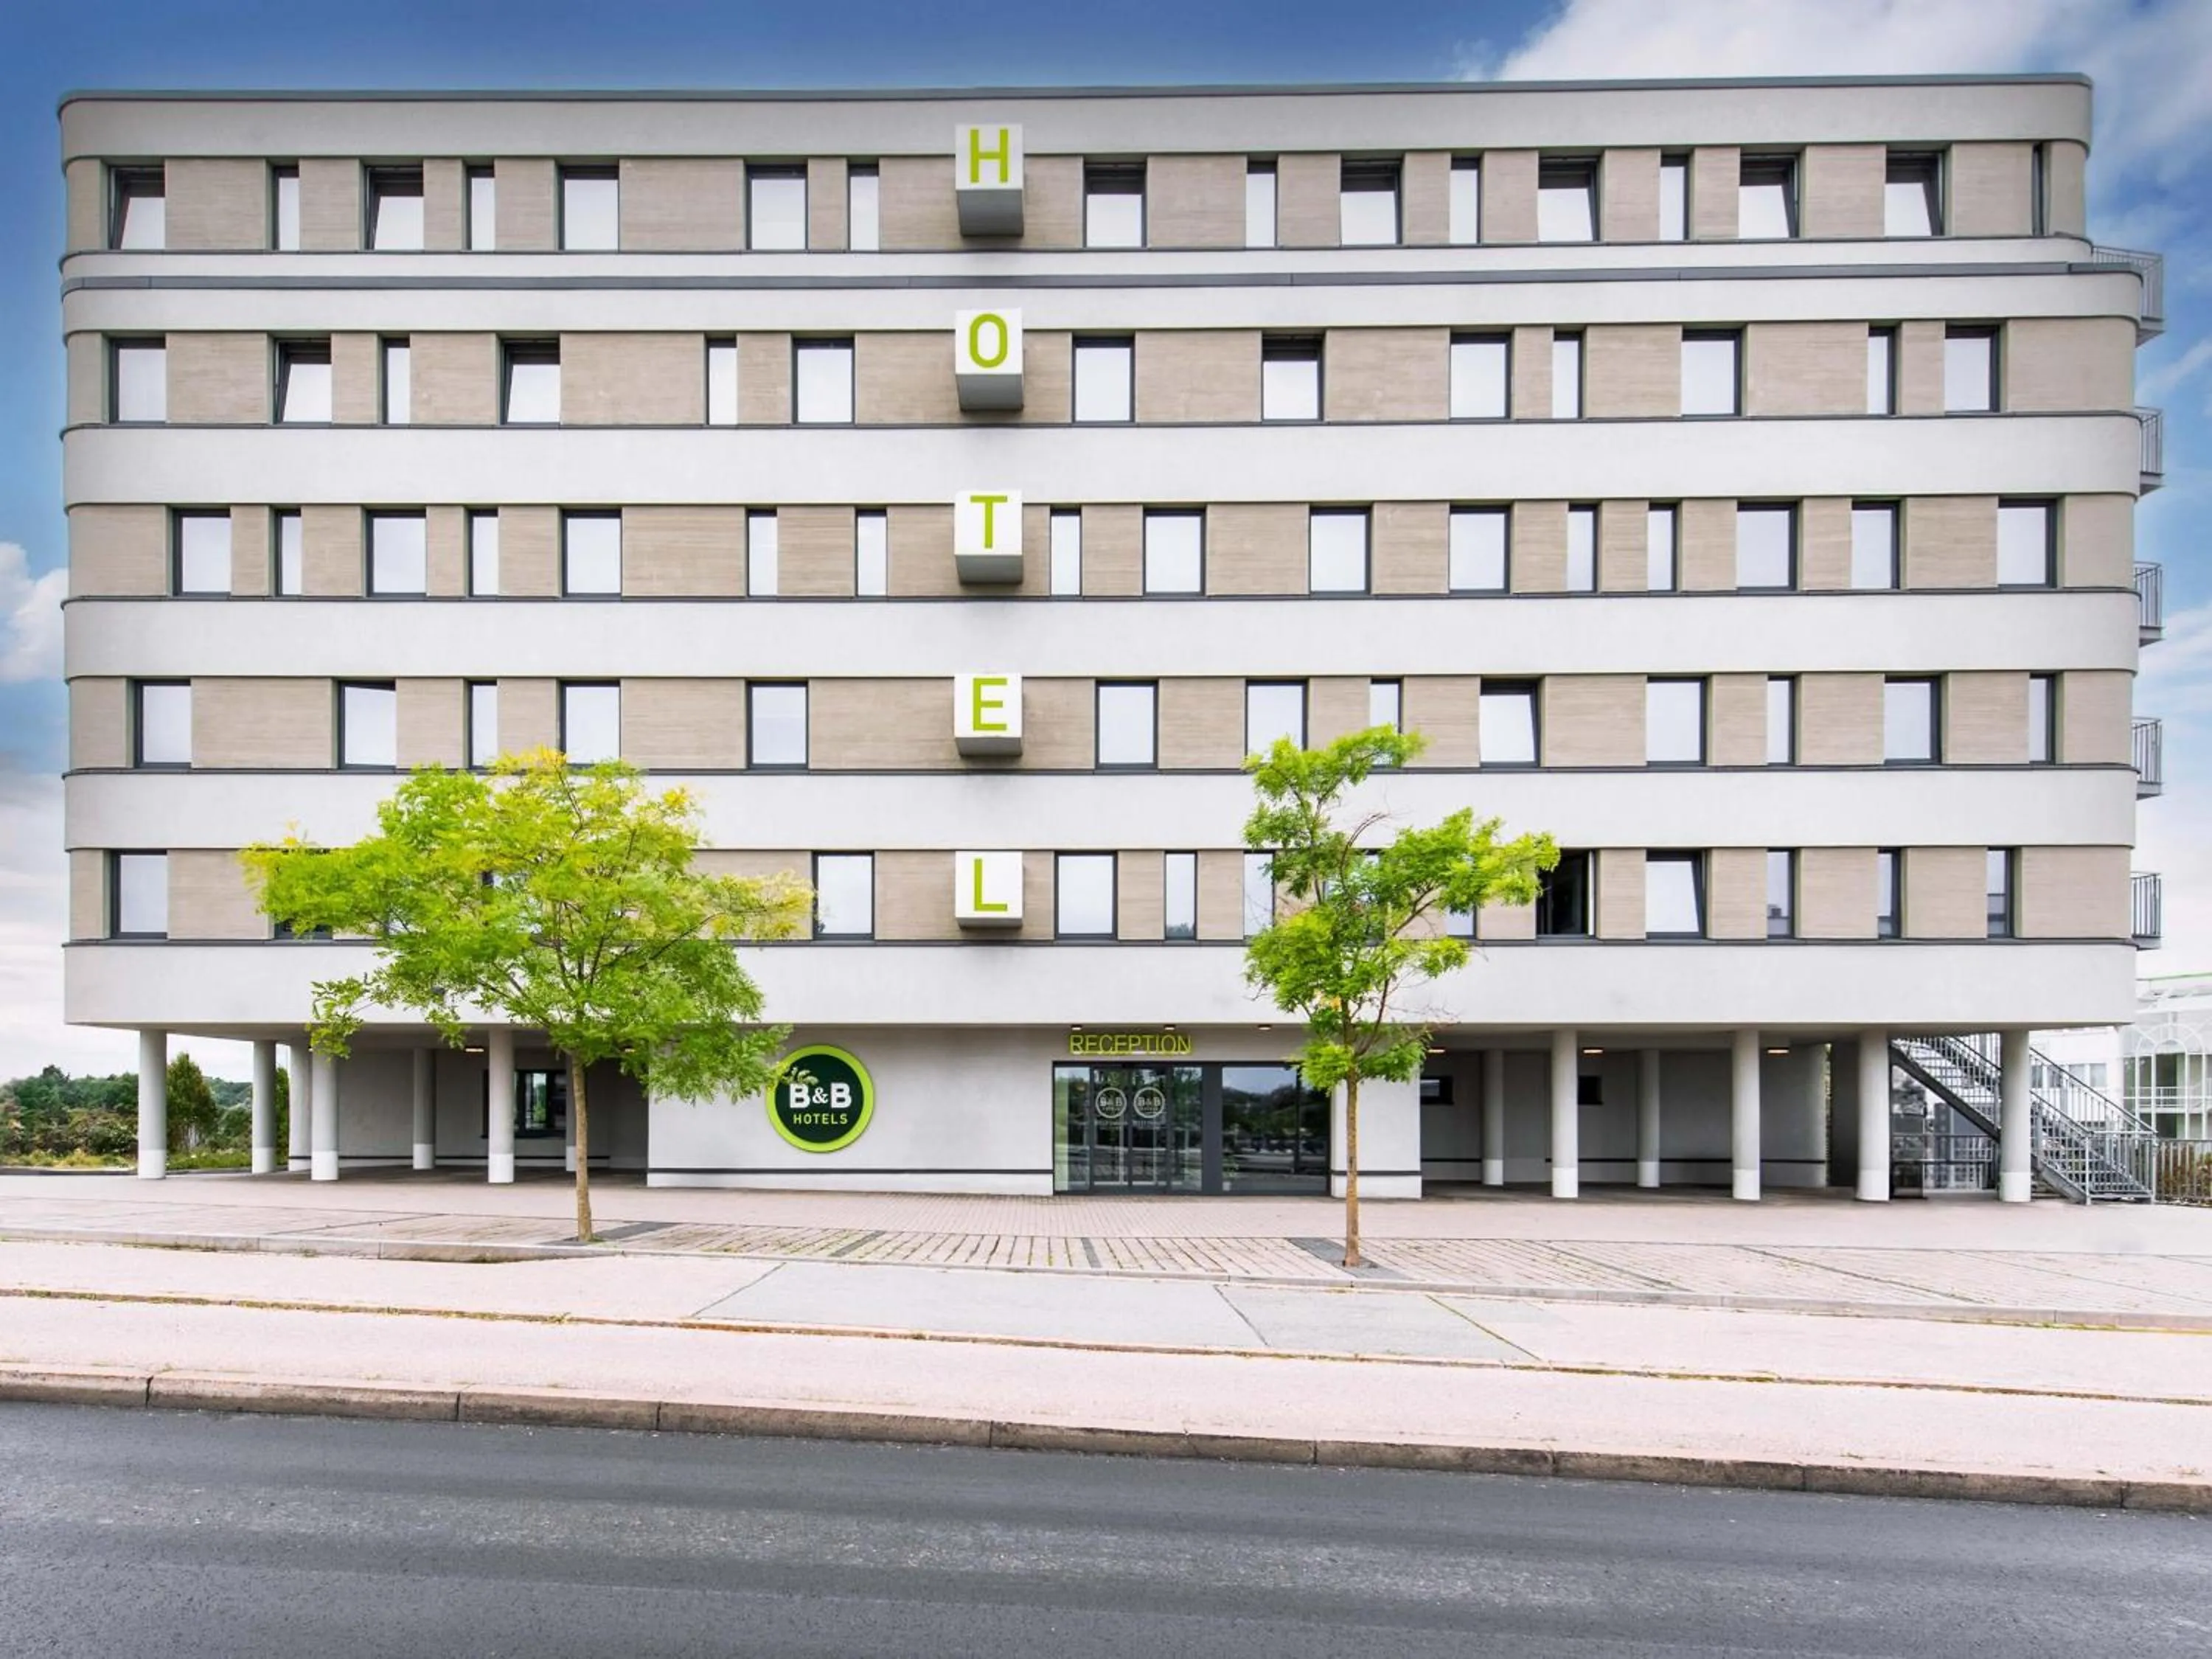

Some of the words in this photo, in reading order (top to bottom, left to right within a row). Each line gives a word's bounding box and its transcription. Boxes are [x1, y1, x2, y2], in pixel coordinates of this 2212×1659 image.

[969, 128, 1009, 912] HOTEL
[1069, 1034, 1192, 1054] RECEPTION
[789, 1082, 852, 1109] B&B
[793, 1113, 849, 1125] HOTELS
